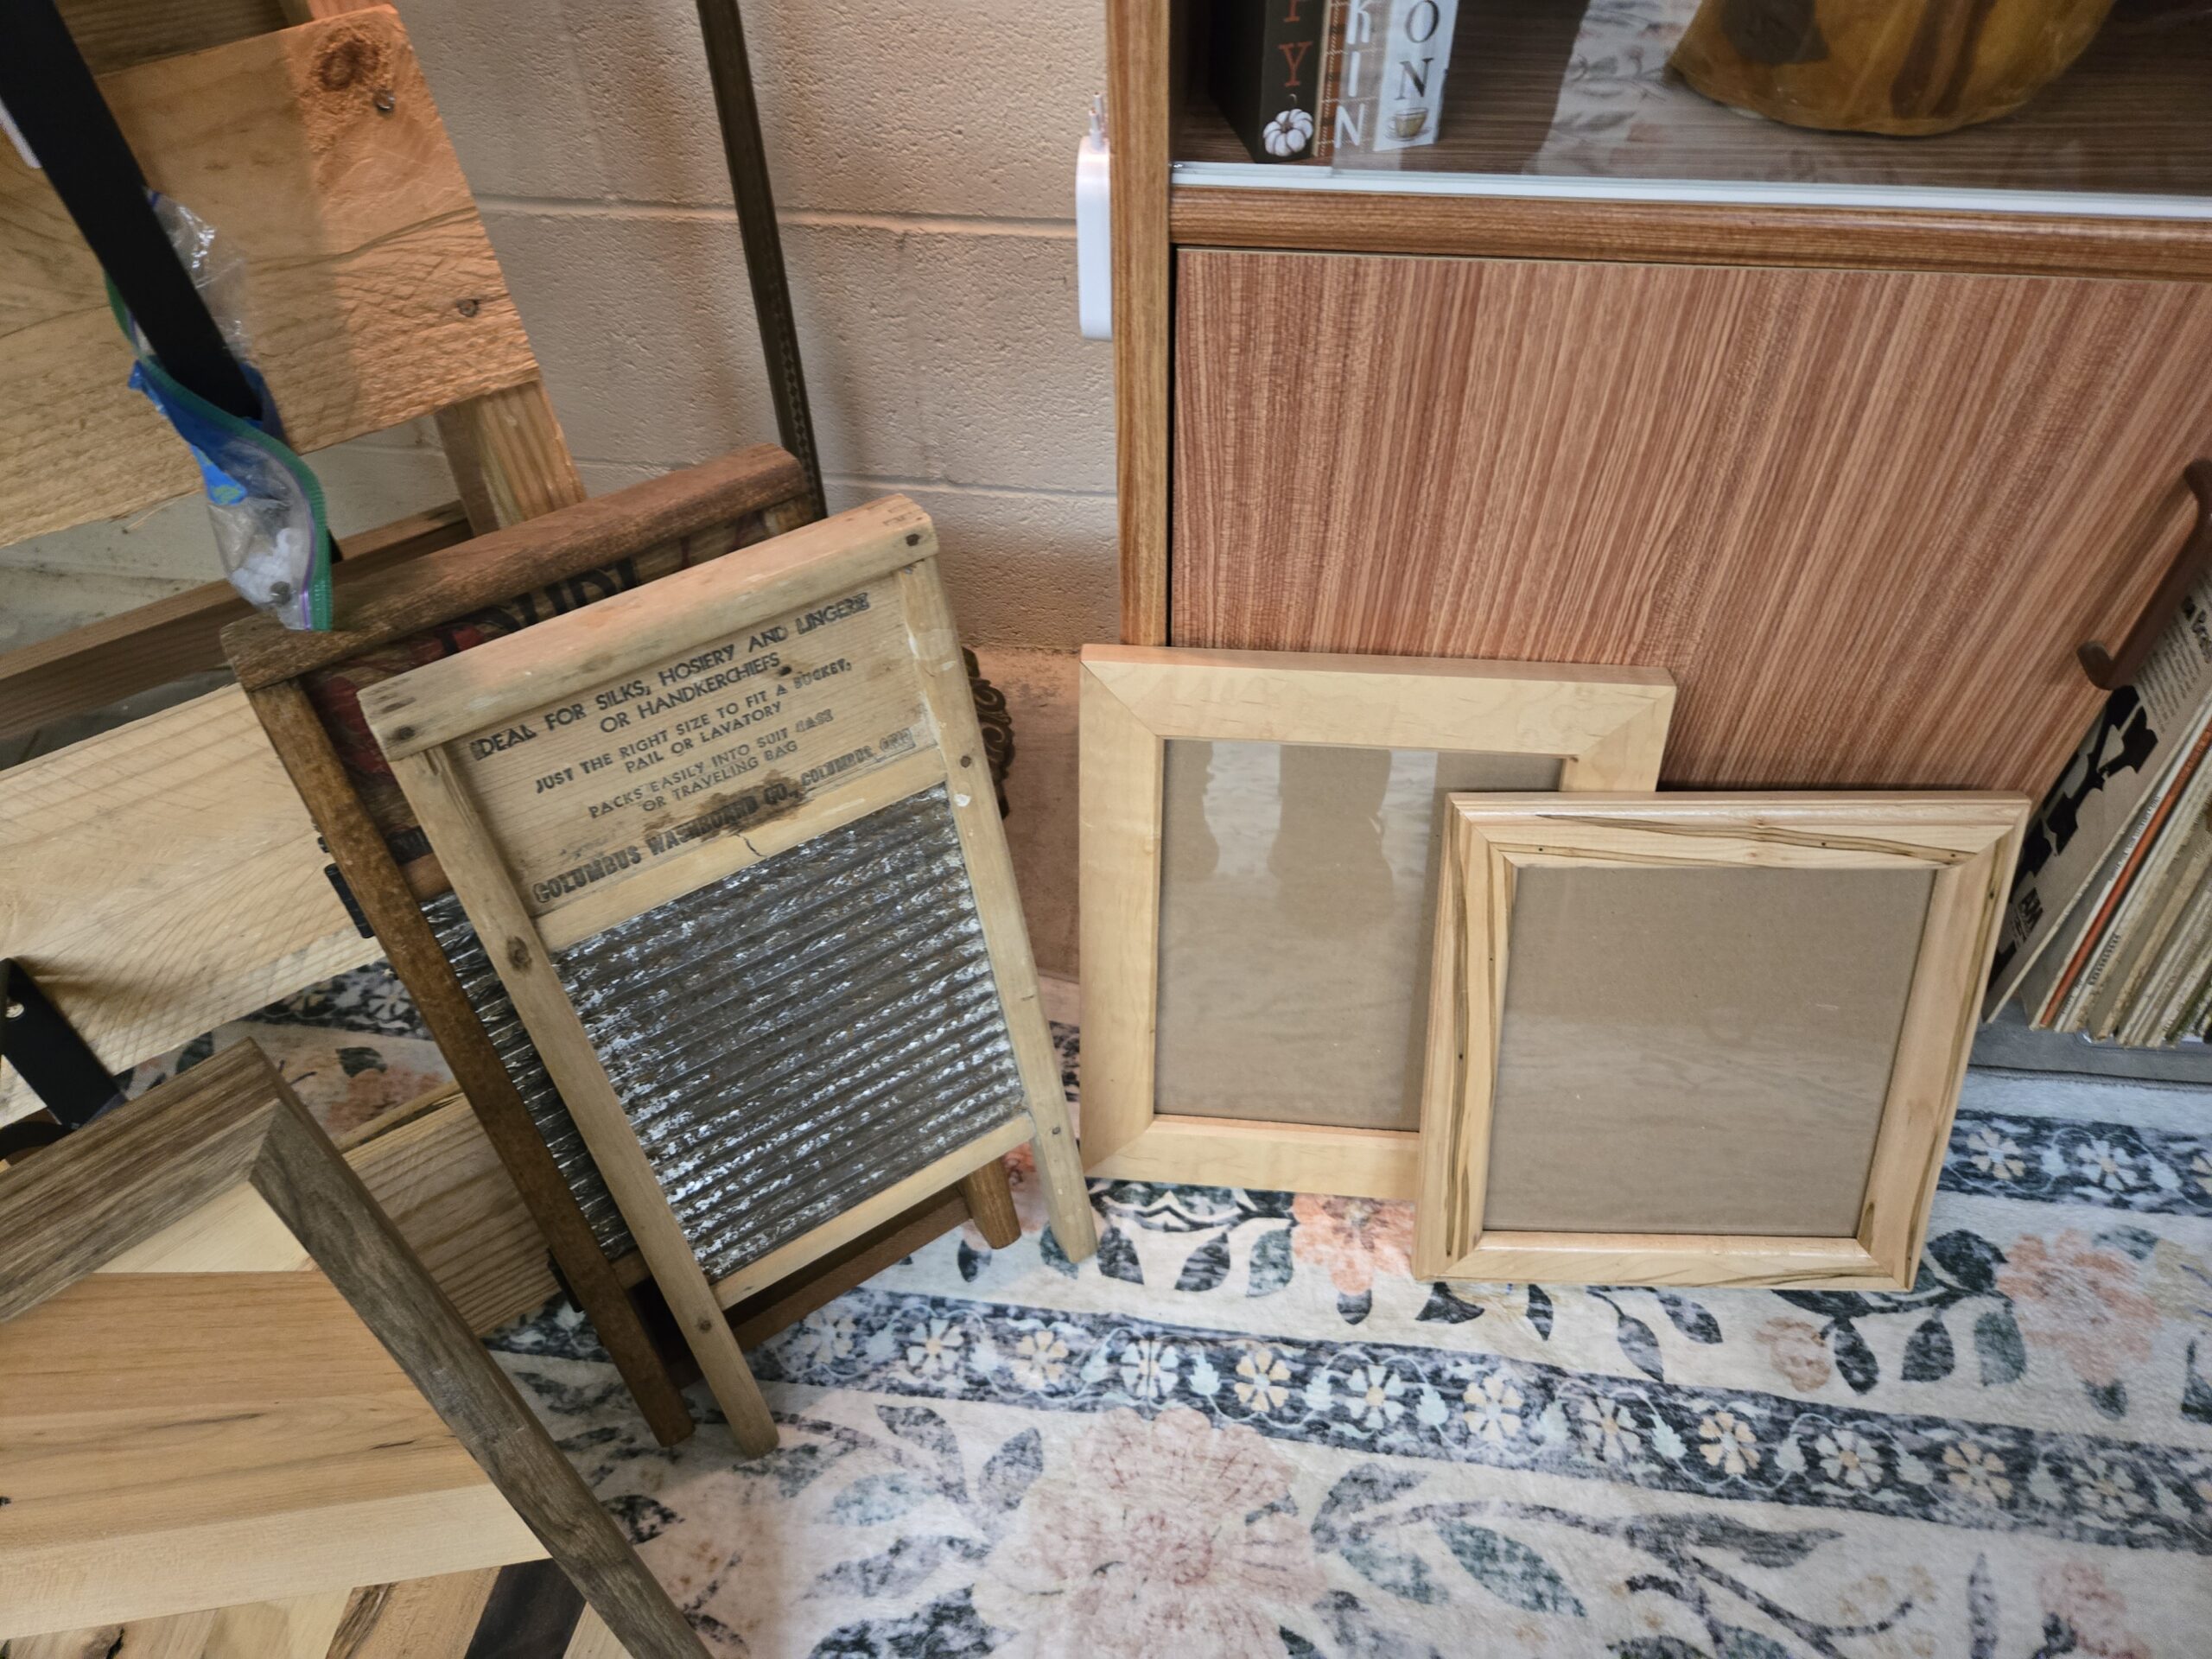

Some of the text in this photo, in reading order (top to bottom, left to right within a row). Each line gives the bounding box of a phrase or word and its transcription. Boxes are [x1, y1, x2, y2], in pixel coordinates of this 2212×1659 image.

[469, 592, 871, 761] IDEAL FOR SILKS, HOSIERY AND LINGERIE
[600, 652, 781, 742] OR HANDKERCHIEFS
[535, 767, 575, 794] JUST
[578, 753, 613, 775] THE
[618, 730, 669, 760] RIGHT
[675, 713, 711, 736] SIZE
[715, 702, 740, 719] TO
[745, 690, 768, 709] FIT
[775, 683, 789, 697] A
[588, 708, 836, 819] PACKS EASILY INTO SUIT CASE
[624, 700, 782, 774] PAIL OR LAVATORY
[642, 740, 799, 812] OR TRAVELING BAG
[532, 845, 644, 905] COLUMBUS
[645, 794, 760, 856] WASHBOARD
